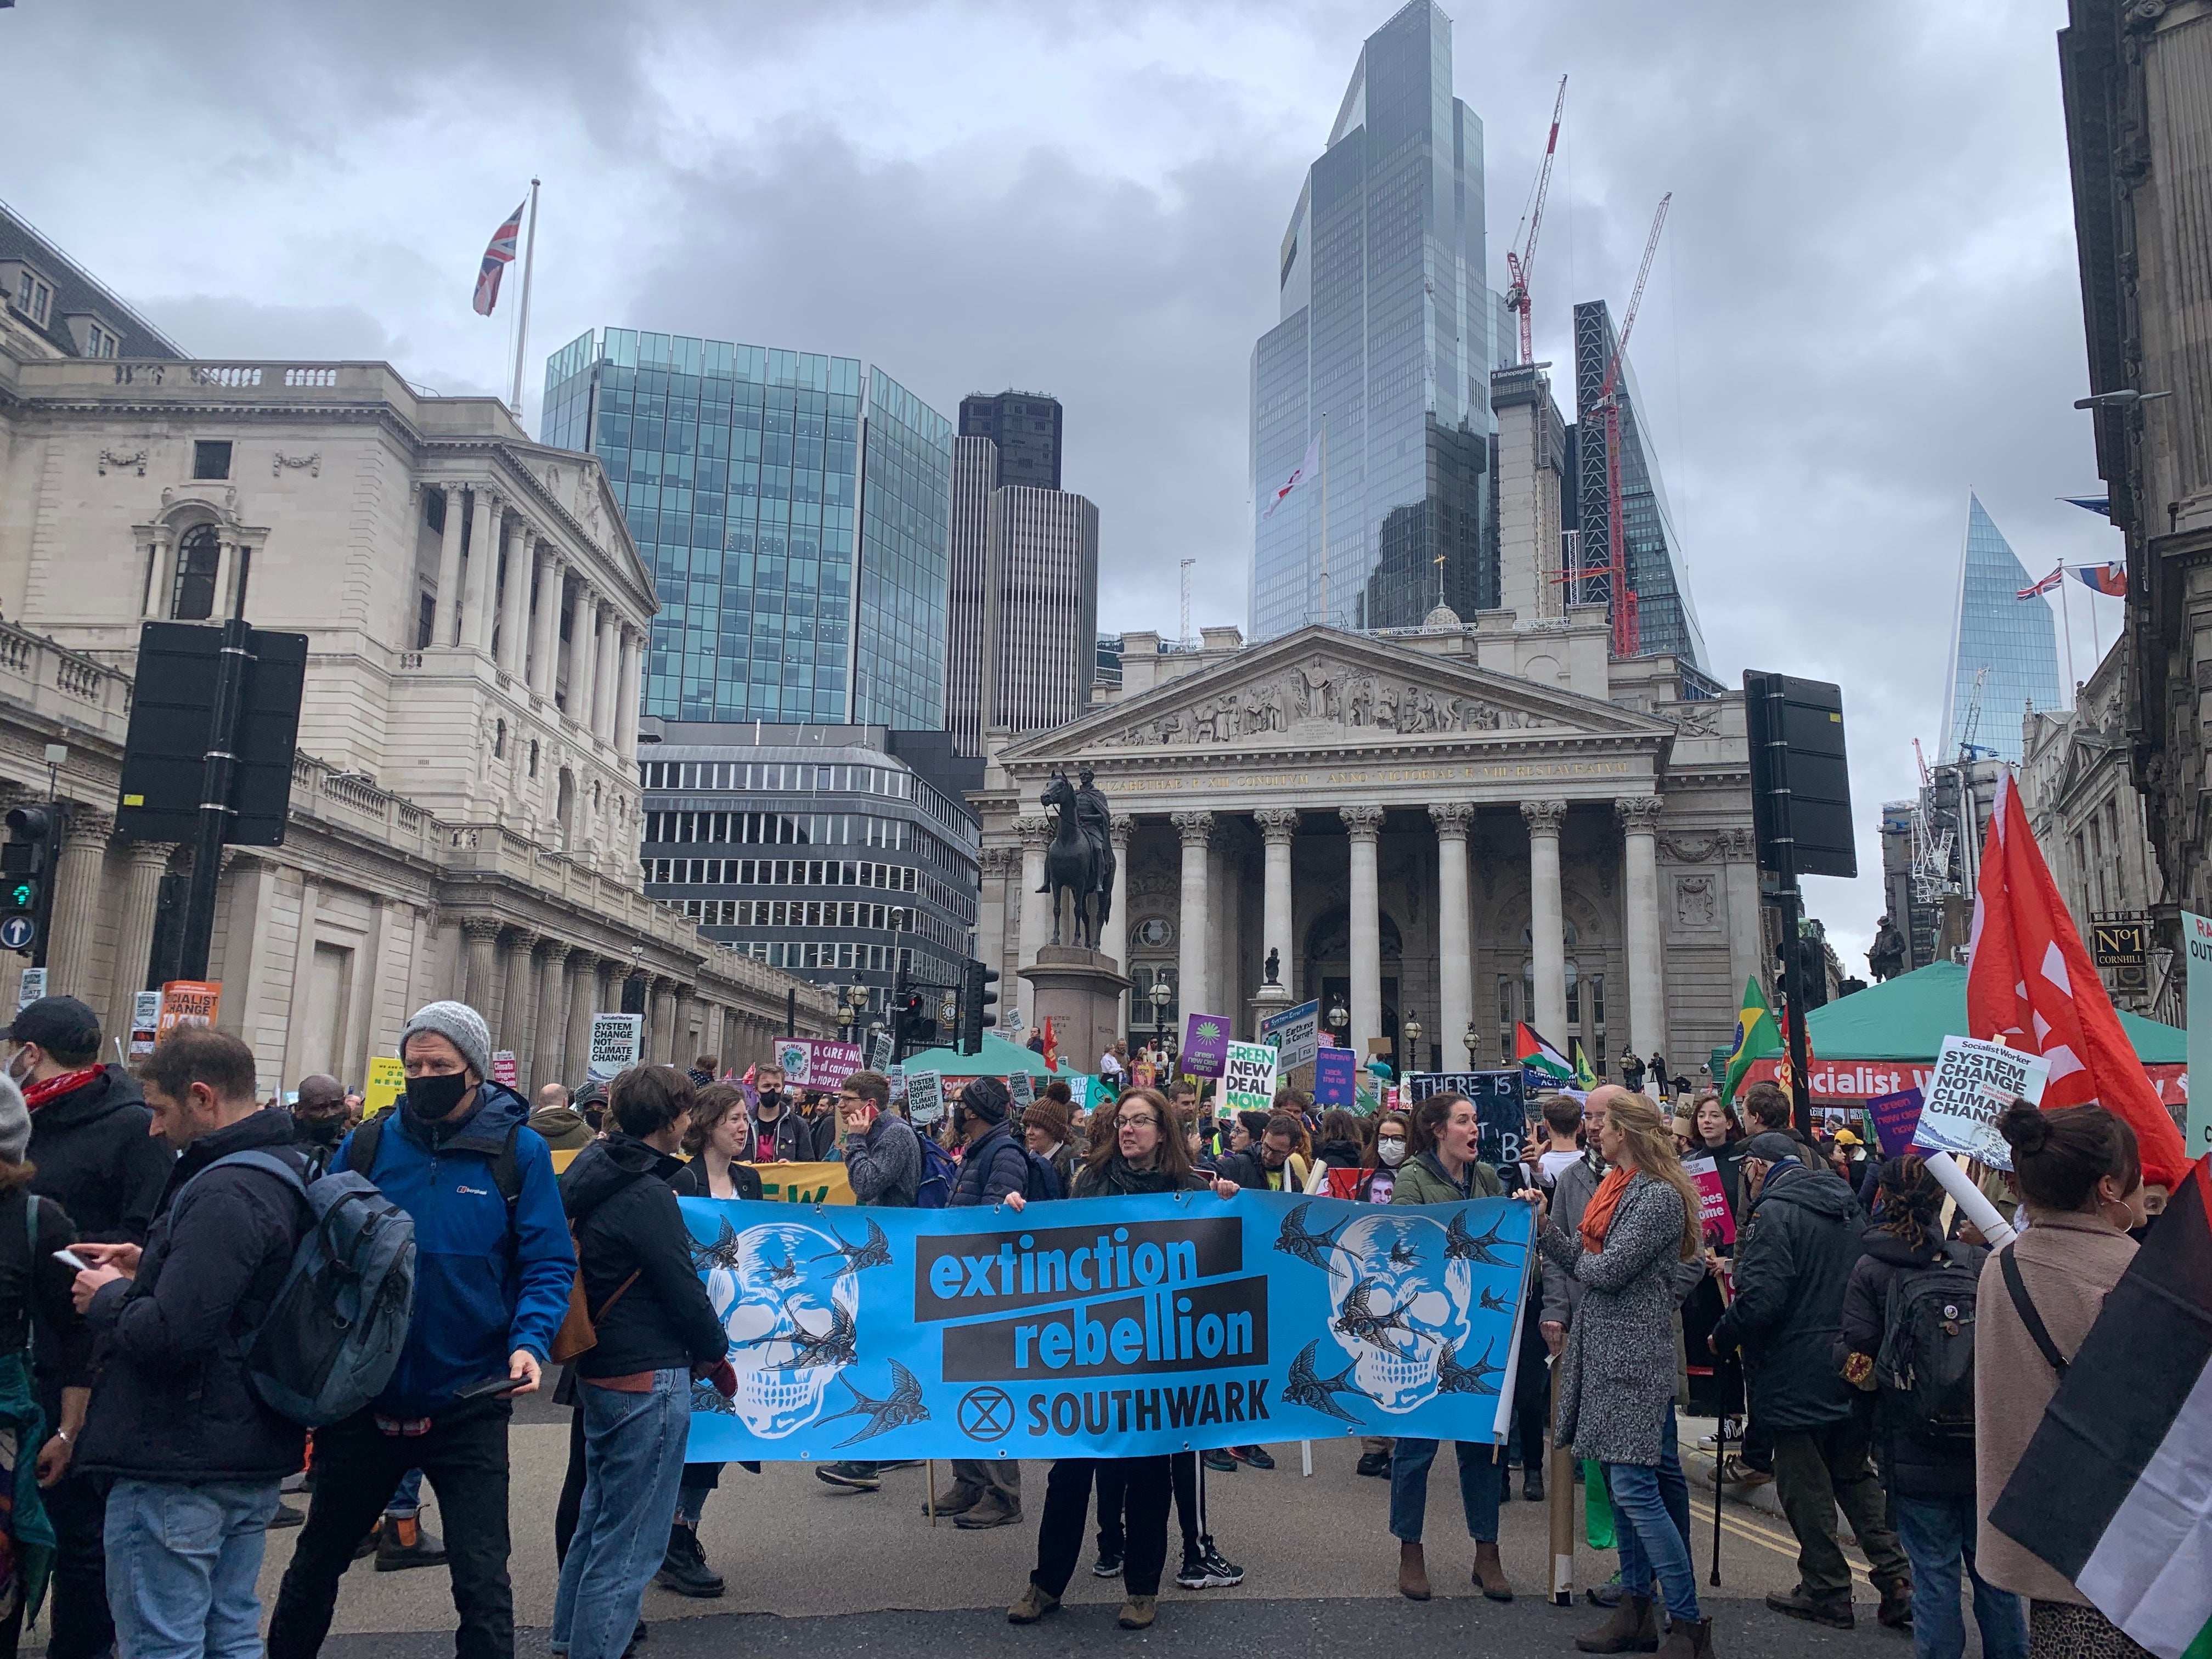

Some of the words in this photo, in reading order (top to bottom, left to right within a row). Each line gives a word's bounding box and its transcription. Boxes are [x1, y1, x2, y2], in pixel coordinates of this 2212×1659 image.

[1498, 368, 1533, 378] Bishopsgate
[1098, 778, 1183, 792] LIZABETHAE
[1192, 778, 1200, 788] R
[1237, 774, 1309, 787] CONDITVM
[1327, 771, 1368, 783] ANNO
[1378, 769, 1455, 781] VICTORIAE
[1465, 768, 1474, 779] R
[1483, 766, 1508, 777] VIII
[1516, 761, 1629, 777] RESTAVRATVM
[2099, 955, 2143, 964] CORNHILL
[1271, 1015, 1289, 1026] System
[594, 1023, 631, 1031] SYSTEM
[1285, 1021, 1314, 1037] Earth.exe
[594, 1030, 633, 1039] CHANGE
[1292, 1028, 1313, 1042] Corrupt
[592, 1046, 633, 1054] CLIMATE
[781, 1044, 807, 1057] WOMEN'S
[813, 1045, 820, 1057] A
[822, 1046, 843, 1060] CARE
[1194, 1051, 1215, 1059] green
[1226, 1044, 1275, 1065] GREEN
[1303, 1047, 1312, 1056] FIX
[1962, 1041, 2000, 1054] Socialist
[2000, 1048, 2032, 1065] Worker
[592, 1054, 631, 1062] CHANGE
[1187, 1057, 1203, 1065] new
[1204, 1058, 1219, 1066] deal
[494, 1062, 514, 1070] Climate
[797, 1059, 809, 1079] STRIKE
[811, 1062, 820, 1070] for
[820, 1060, 829, 1072] all
[829, 1064, 853, 1077] caring
[1193, 1064, 1212, 1073] rising
[1231, 1060, 1273, 1078] NEW
[1943, 1051, 2027, 1082] SYSTEM
[817, 1075, 838, 1087] PEOPLE
[909, 1077, 934, 1087] SYSTEM
[1071, 1076, 1088, 1087] STO
[1937, 1075, 1980, 1092] NOT
[1941, 1063, 2027, 1096] CHANGE
[909, 1083, 936, 1093] CHANGE
[1071, 1085, 1087, 1095] WA
[1226, 1075, 1272, 1096] DEAL
[1415, 1076, 1481, 1100] THERE
[1493, 1076, 1511, 1096] IS
[1983, 1084, 1995, 1092] One
[910, 1091, 924, 1099] NOT
[911, 1094, 938, 1105] CLIMATE
[1070, 1094, 1086, 1103] STO
[1227, 1091, 1271, 1110] NOW
[911, 1101, 938, 1112] CHANGE
[1879, 1098, 1911, 1112] green
[1933, 1088, 2009, 1115] CLIMAT
[1877, 1114, 1900, 1124] new
[1893, 1124, 1916, 1135] now
[929, 1227, 1198, 1300] extinction
[1014, 1288, 1254, 1369] rebellion
[1027, 1378, 1270, 1437] SOUTHWARK
